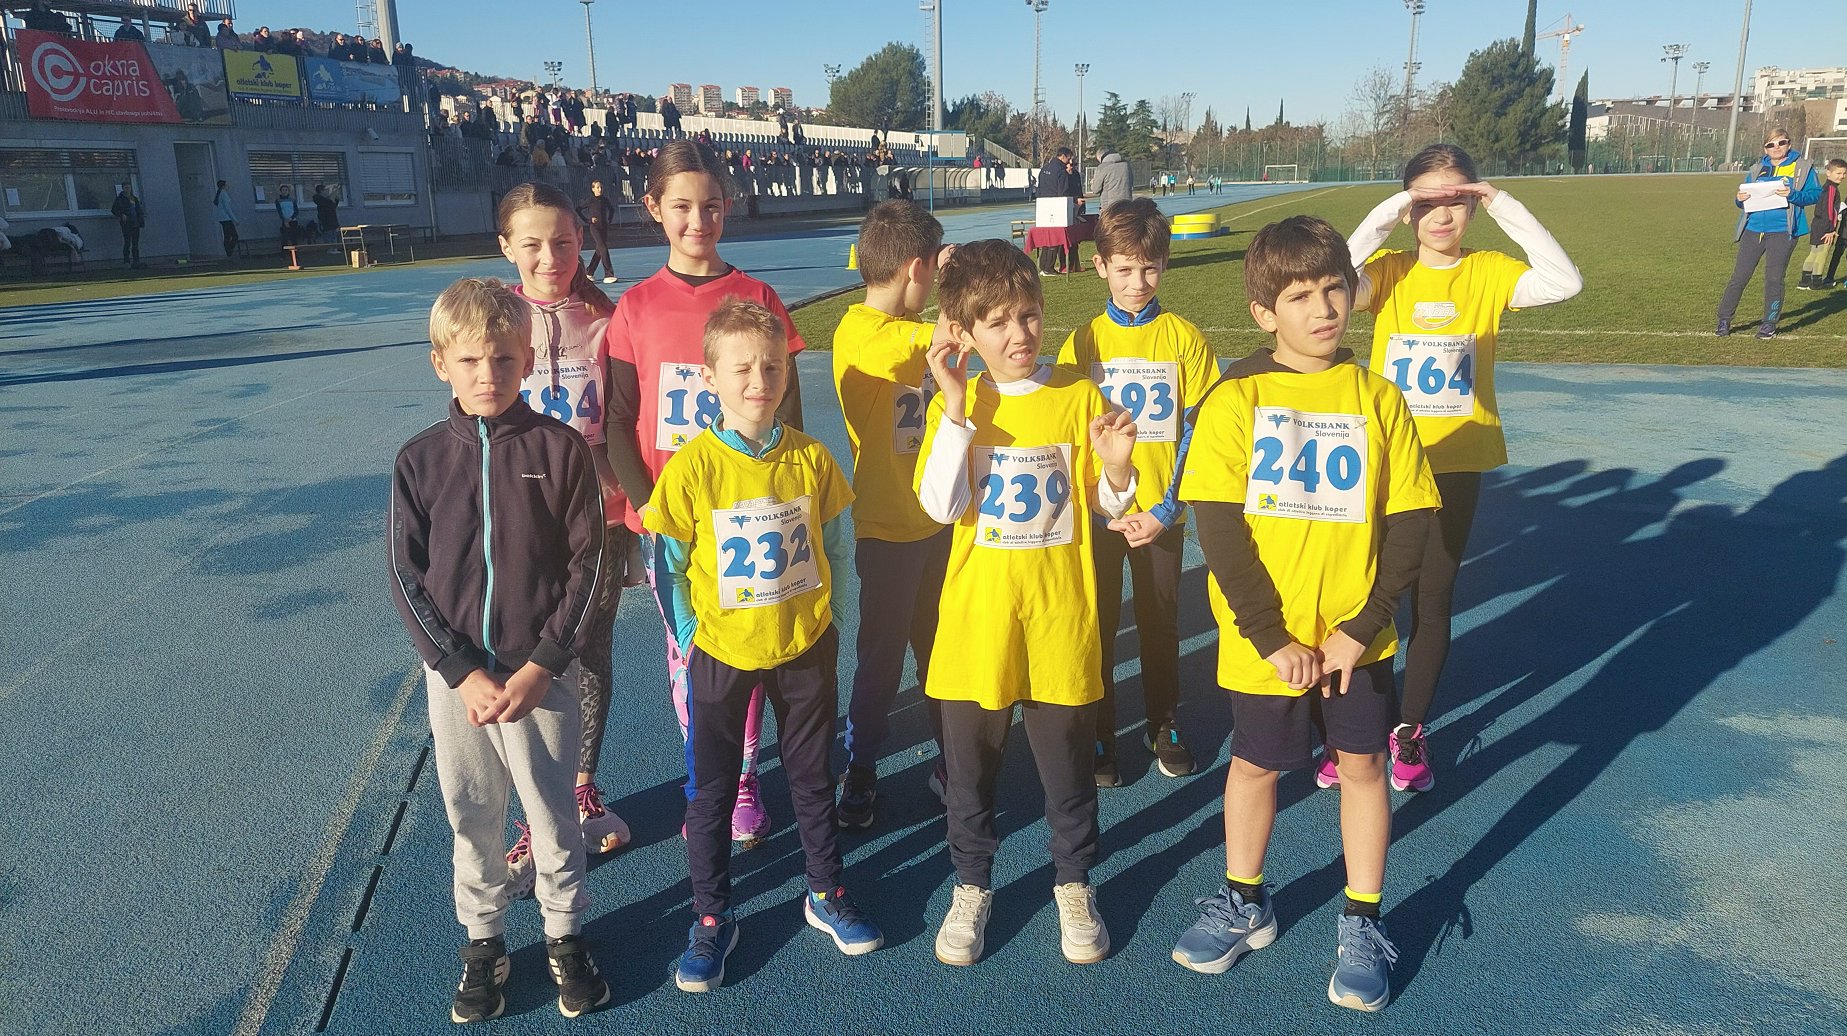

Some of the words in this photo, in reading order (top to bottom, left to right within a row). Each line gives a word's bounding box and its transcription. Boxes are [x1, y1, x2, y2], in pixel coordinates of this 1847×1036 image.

[89, 54, 140, 76] okna
[89, 77, 150, 100] capris
[561, 372, 589, 380] Slovenija
[1391, 353, 1473, 396] 164
[519, 379, 602, 424] 84
[1293, 418, 1350, 430] VOLKSBANK
[1315, 430, 1350, 439] Slovenija
[1012, 452, 1057, 463] VOLKSBANK
[1251, 436, 1362, 494] 240
[978, 469, 1071, 523] 239
[1278, 501, 1307, 509] atletski
[1307, 503, 1323, 511] klub
[1324, 505, 1348, 513] koper
[754, 505, 802, 522] VOLKSBANK
[721, 523, 811, 580] 232
